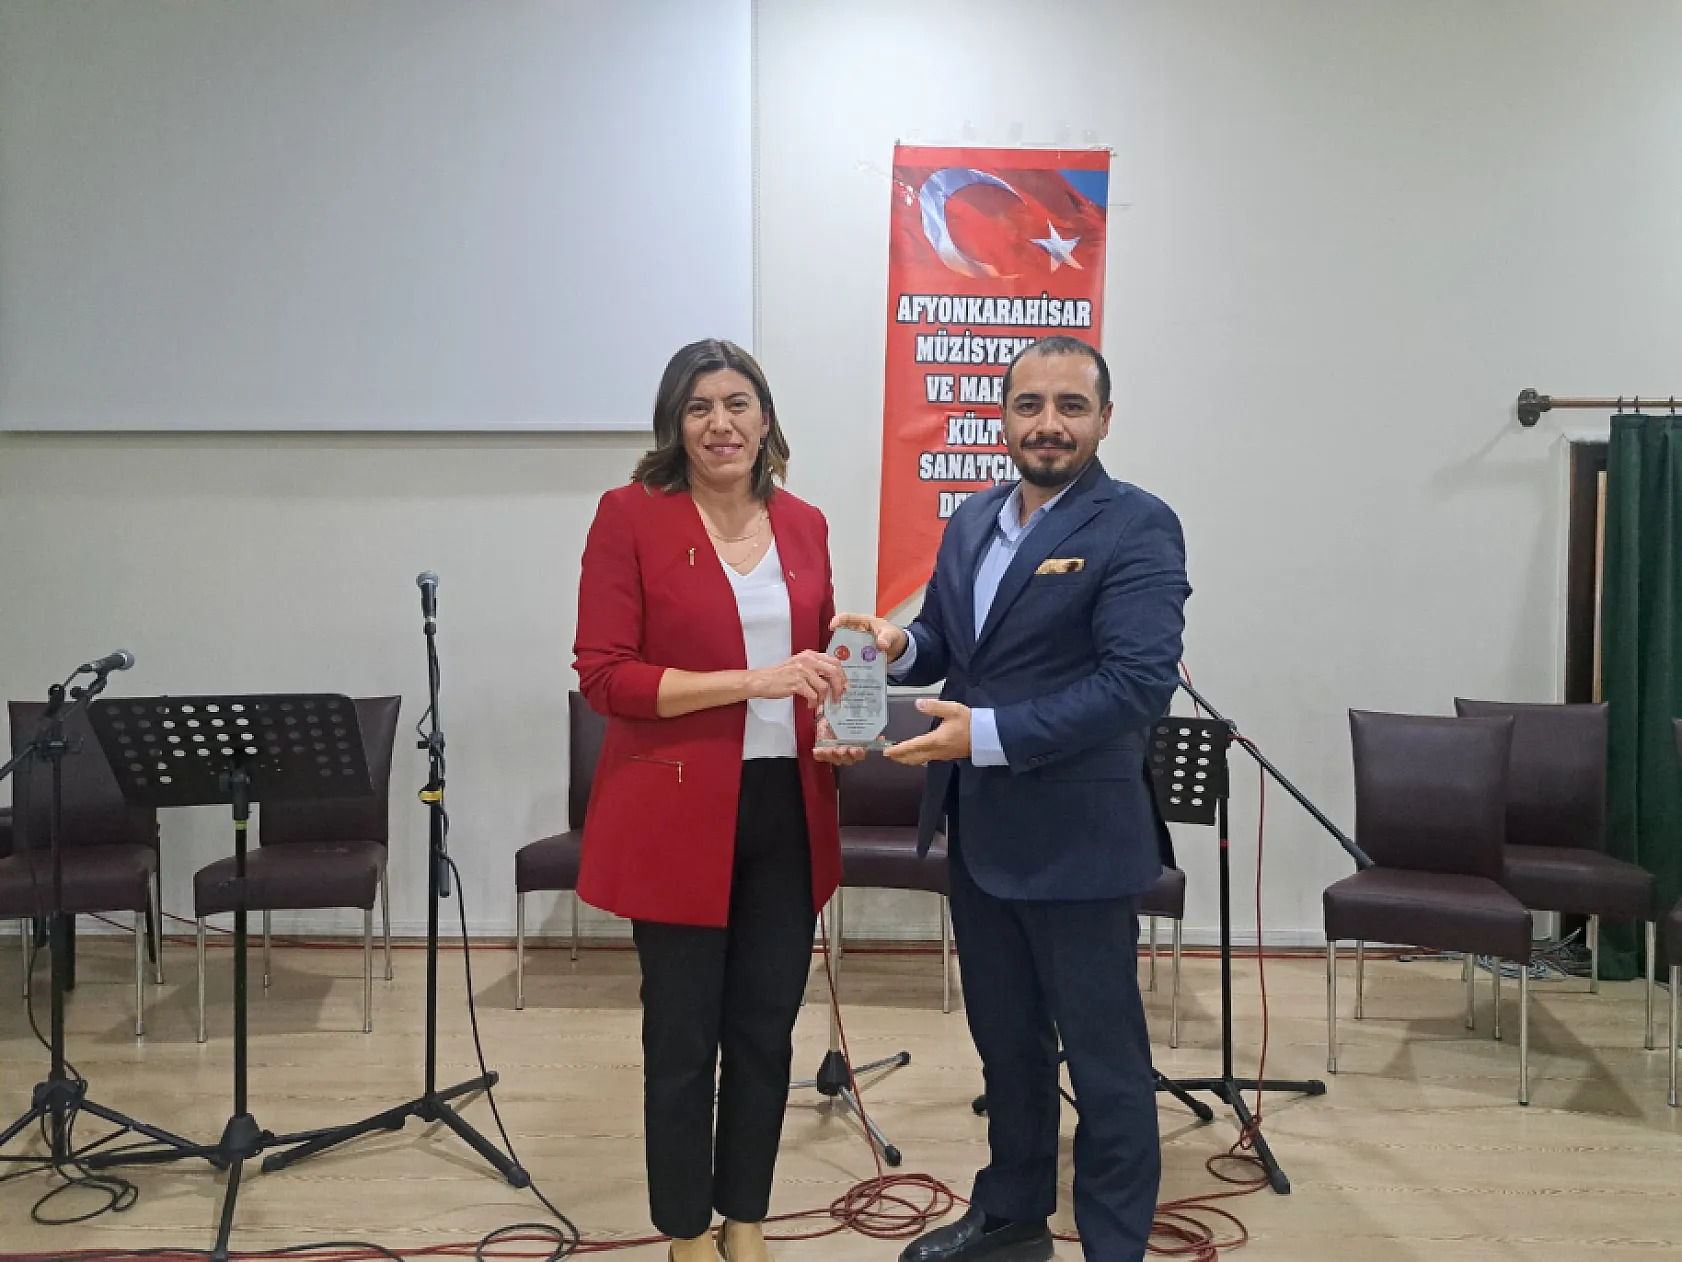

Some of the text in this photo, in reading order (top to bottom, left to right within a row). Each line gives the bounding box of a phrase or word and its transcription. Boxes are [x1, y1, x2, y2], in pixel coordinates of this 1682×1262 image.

[897, 292, 1092, 327] AFYONKARAHİSAR
[916, 328, 1036, 365] MÜZİSYEN
[925, 373, 955, 403] VE
[947, 412, 1008, 445] KÜLT
